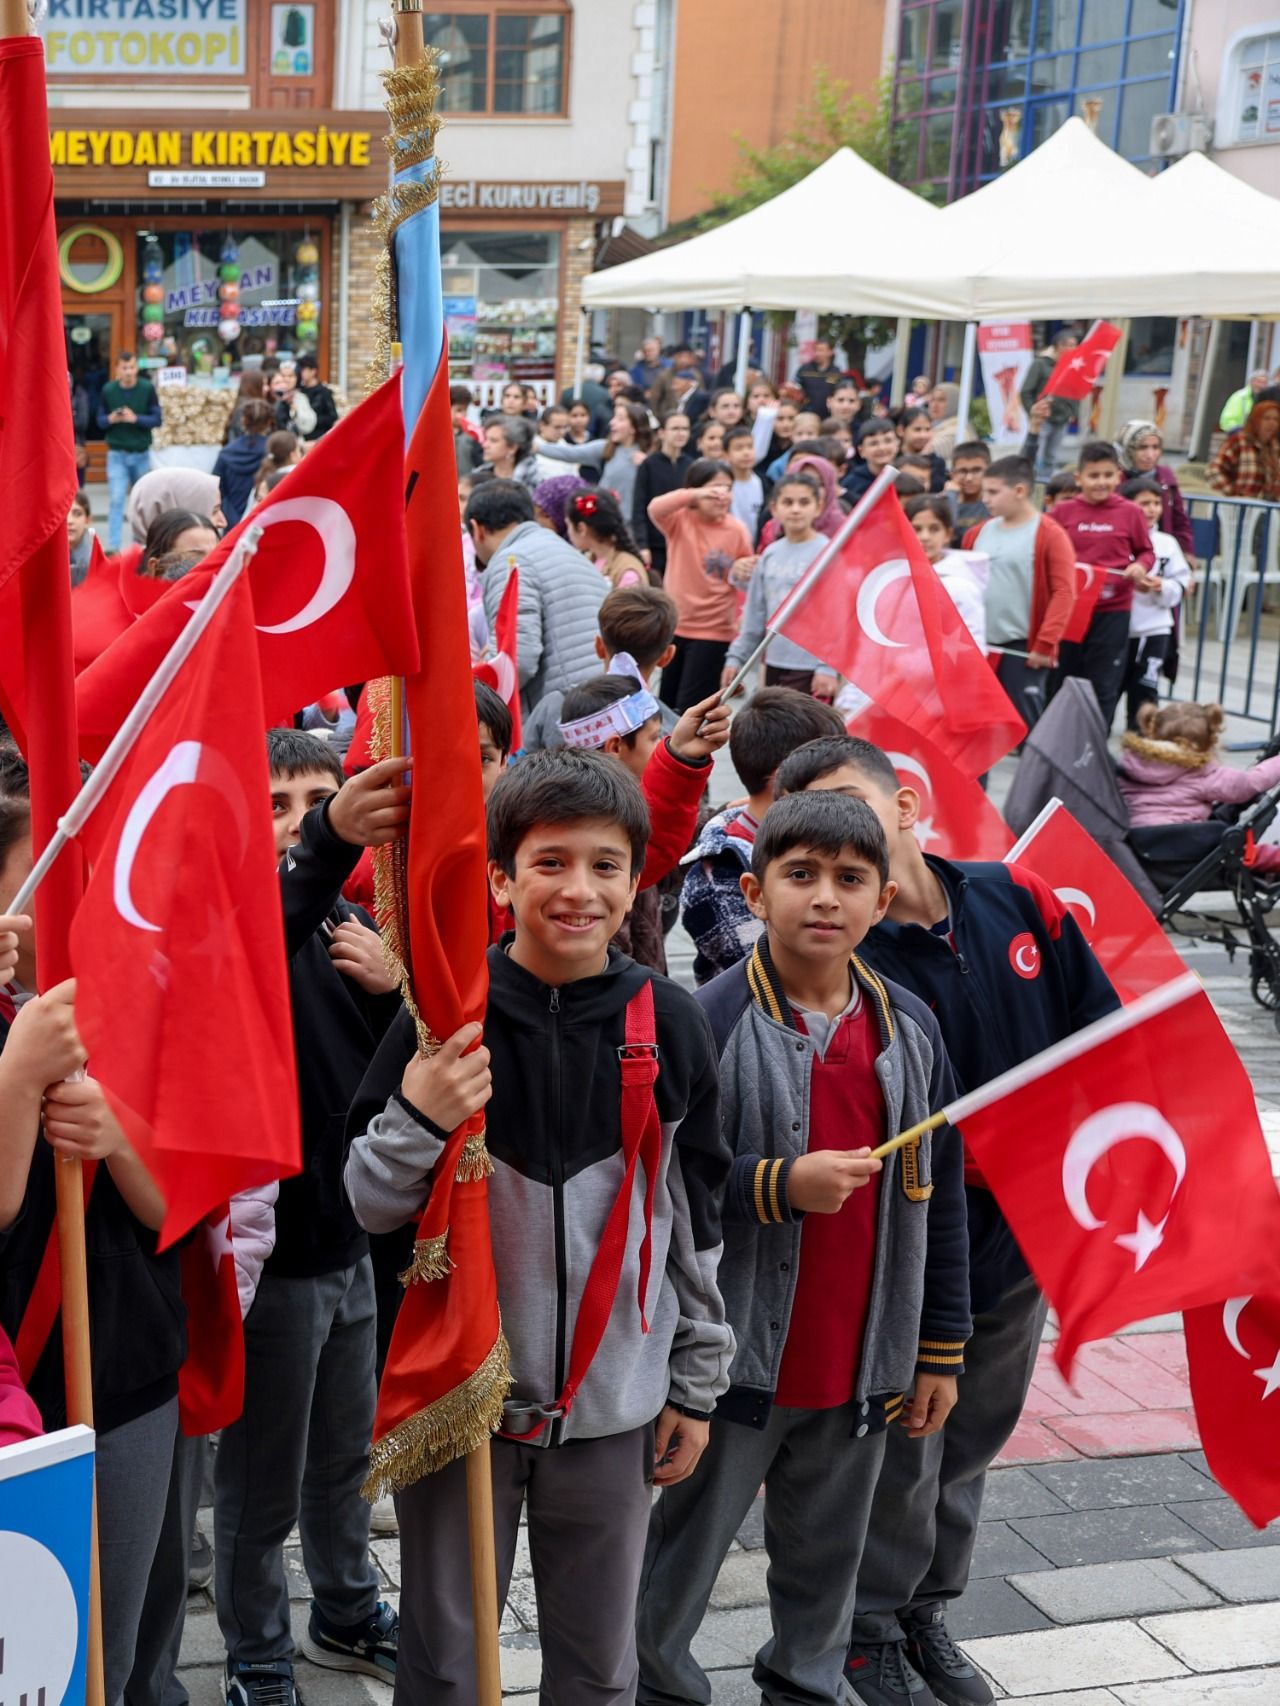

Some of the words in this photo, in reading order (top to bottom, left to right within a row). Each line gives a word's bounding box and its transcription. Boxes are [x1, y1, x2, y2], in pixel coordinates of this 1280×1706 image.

[46, 25, 239, 65] FOTOKOPİ
[49, 130, 180, 167] MEYDAN
[191, 125, 370, 167] KIRTASİYE
[440, 181, 476, 208] ECİ
[479, 180, 600, 212] KURUYEMİŞ
[169, 266, 273, 310] MEYAN
[186, 308, 294, 325] KIRASIYE
